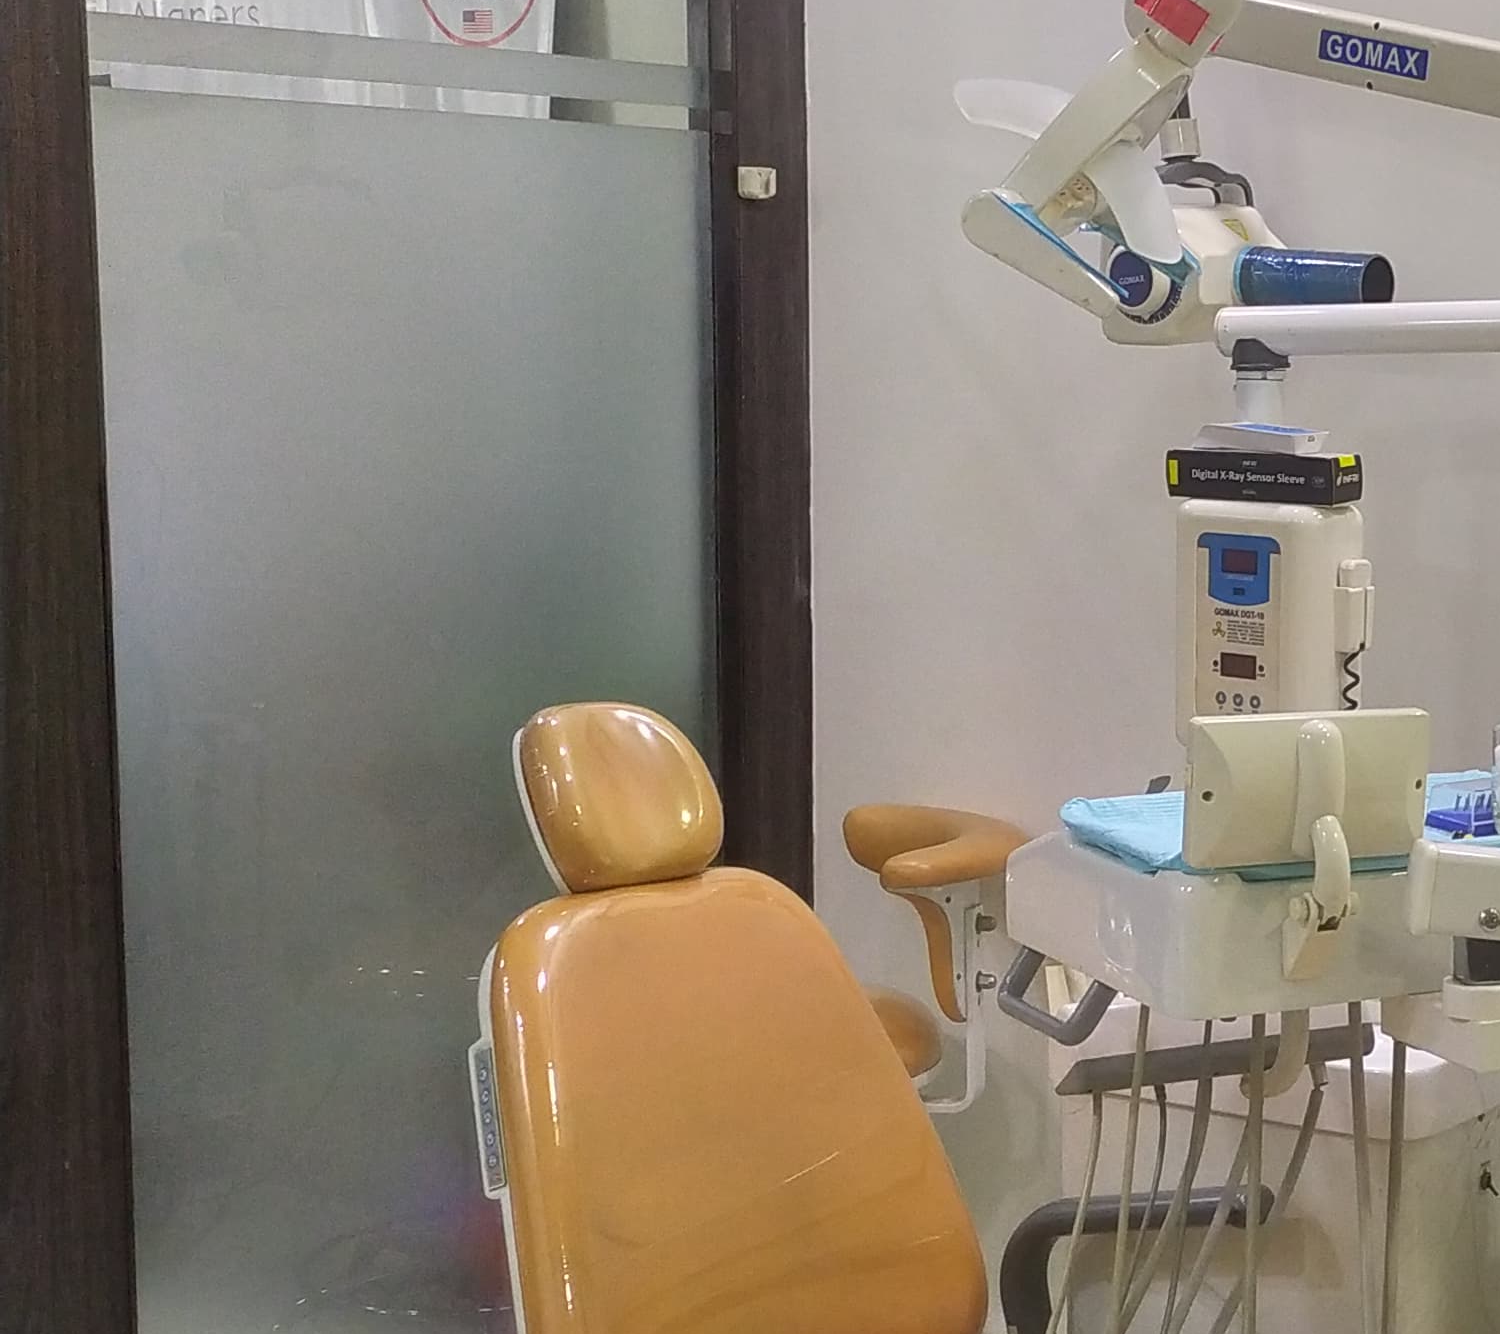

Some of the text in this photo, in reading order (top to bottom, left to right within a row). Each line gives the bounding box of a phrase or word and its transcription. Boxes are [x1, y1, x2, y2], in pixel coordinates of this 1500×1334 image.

[1326, 34, 1420, 76] GOMAX
[1191, 468, 1218, 482] Digital
[1220, 470, 1244, 483] X-Ray
[1246, 471, 1275, 484] Sensor
[1276, 472, 1306, 485] Sleeve
